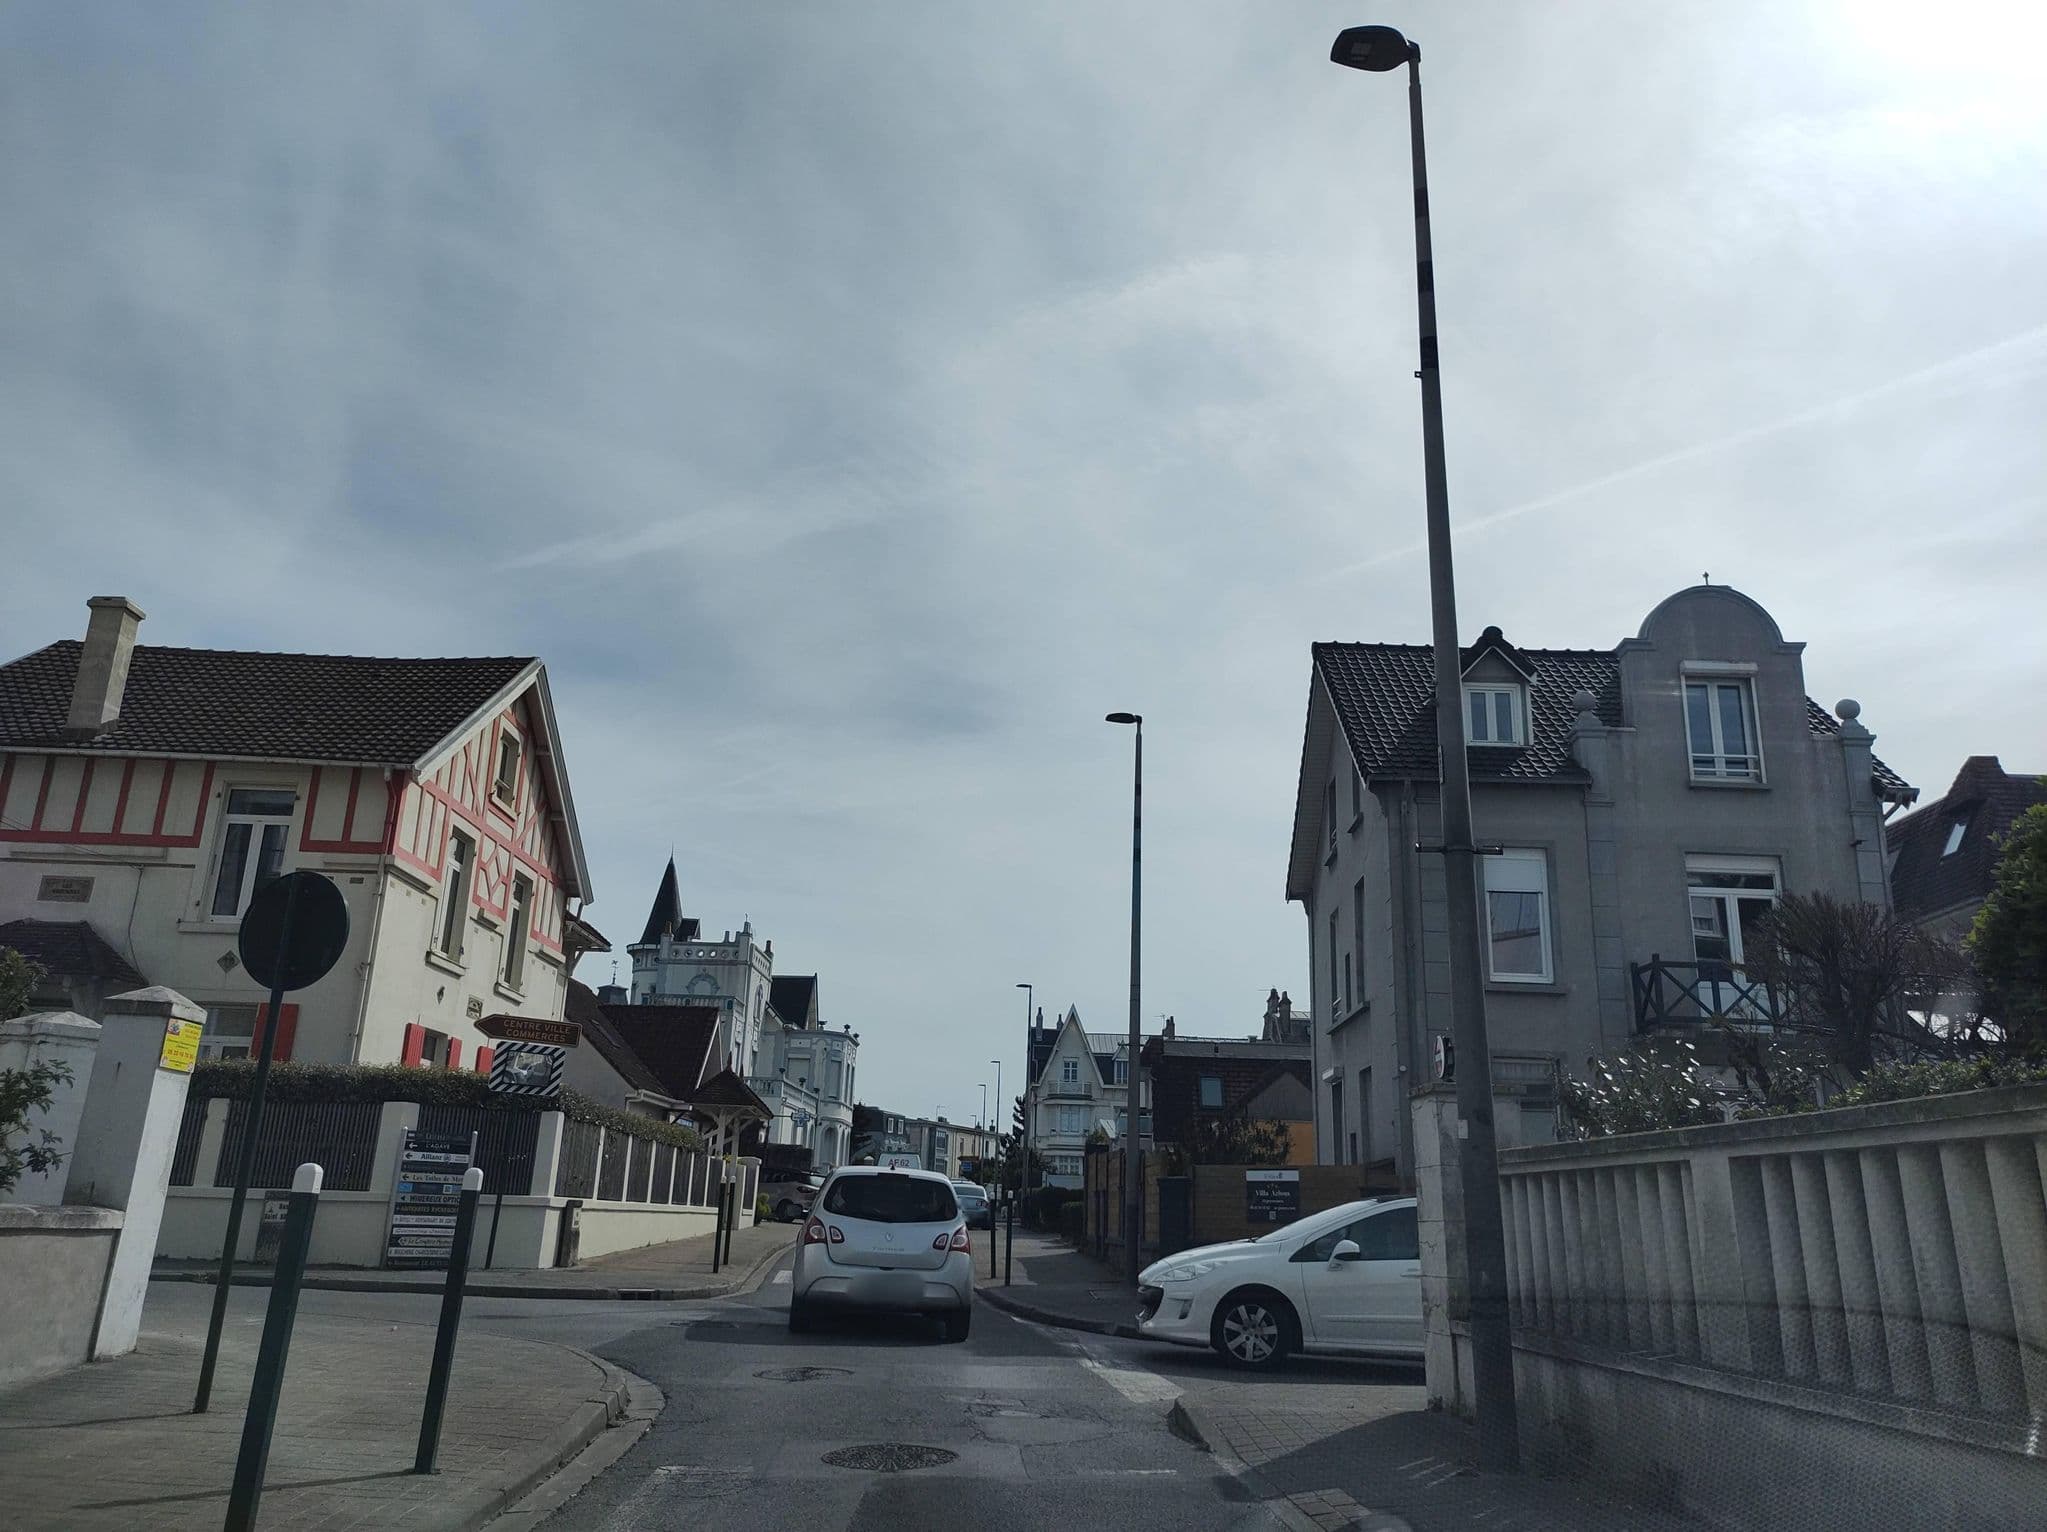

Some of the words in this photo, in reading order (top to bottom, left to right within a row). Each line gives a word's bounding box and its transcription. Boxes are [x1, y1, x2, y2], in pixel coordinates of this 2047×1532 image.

[503, 1019, 542, 1031] CENTRE
[545, 1024, 571, 1034] VILLE
[506, 1029, 566, 1042] COMMERCES
[420, 1153, 442, 1161] Allianz
[409, 1195, 441, 1203] WIMEREUX
